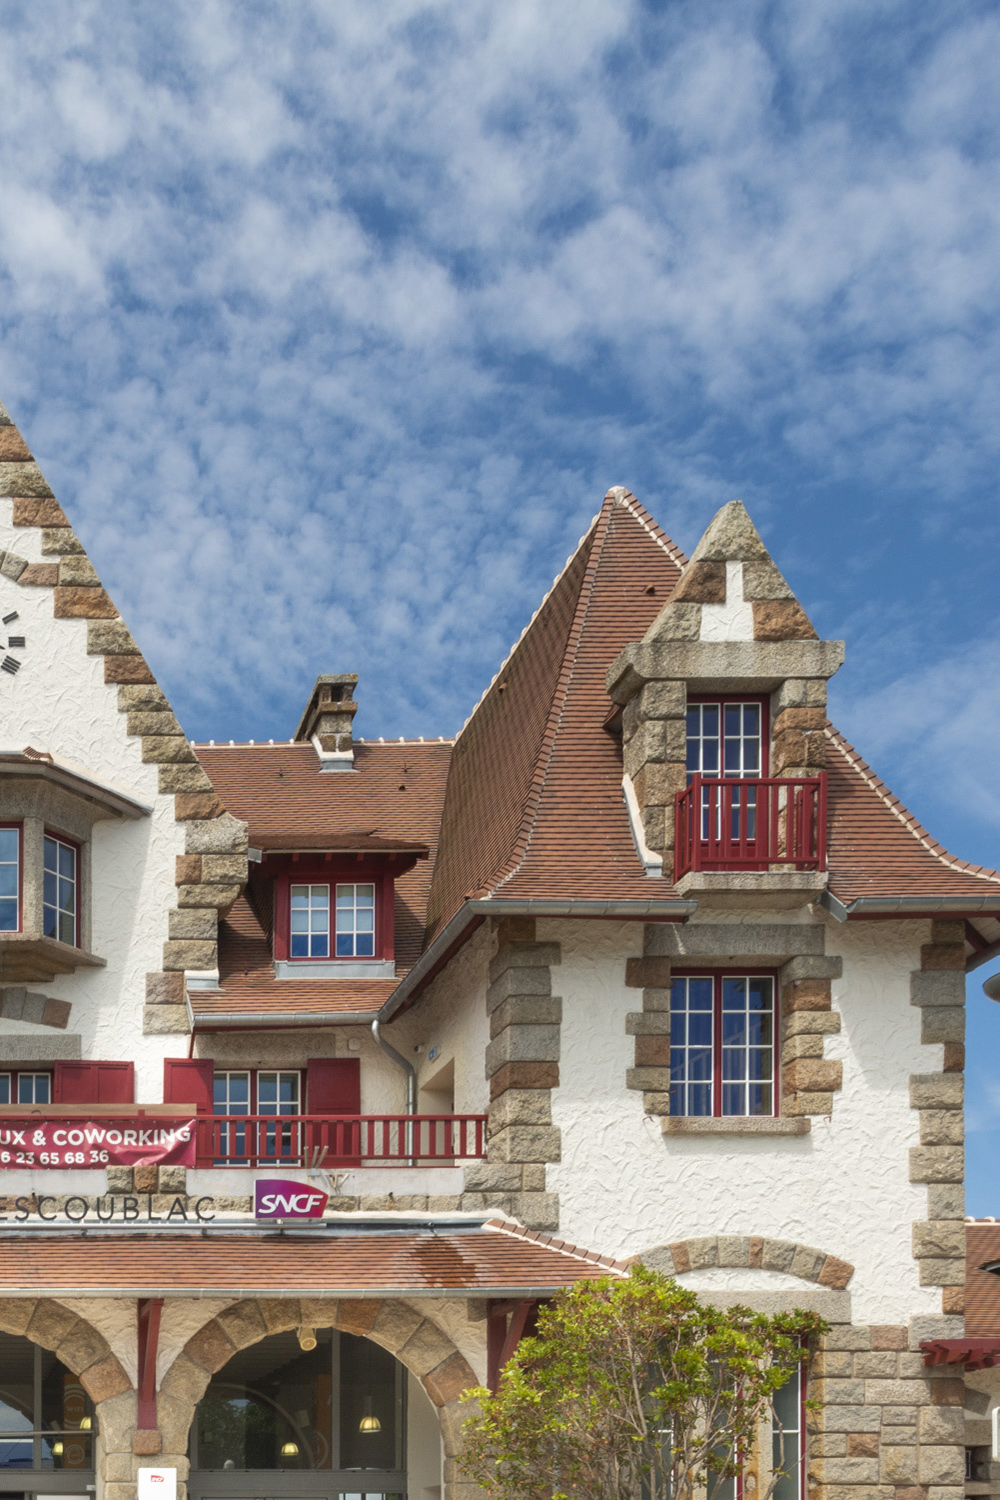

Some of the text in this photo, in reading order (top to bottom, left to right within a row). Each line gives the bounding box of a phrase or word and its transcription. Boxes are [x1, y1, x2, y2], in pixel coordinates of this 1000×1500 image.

[33, 1129, 47, 1146] &
[53, 1127, 191, 1147] COWORKING
[15, 1152, 35, 1164] 23
[39, 1152, 60, 1165] 65
[64, 1152, 85, 1164] 68
[89, 1150, 109, 1163] 36
[258, 1194, 324, 1214] SNCF
